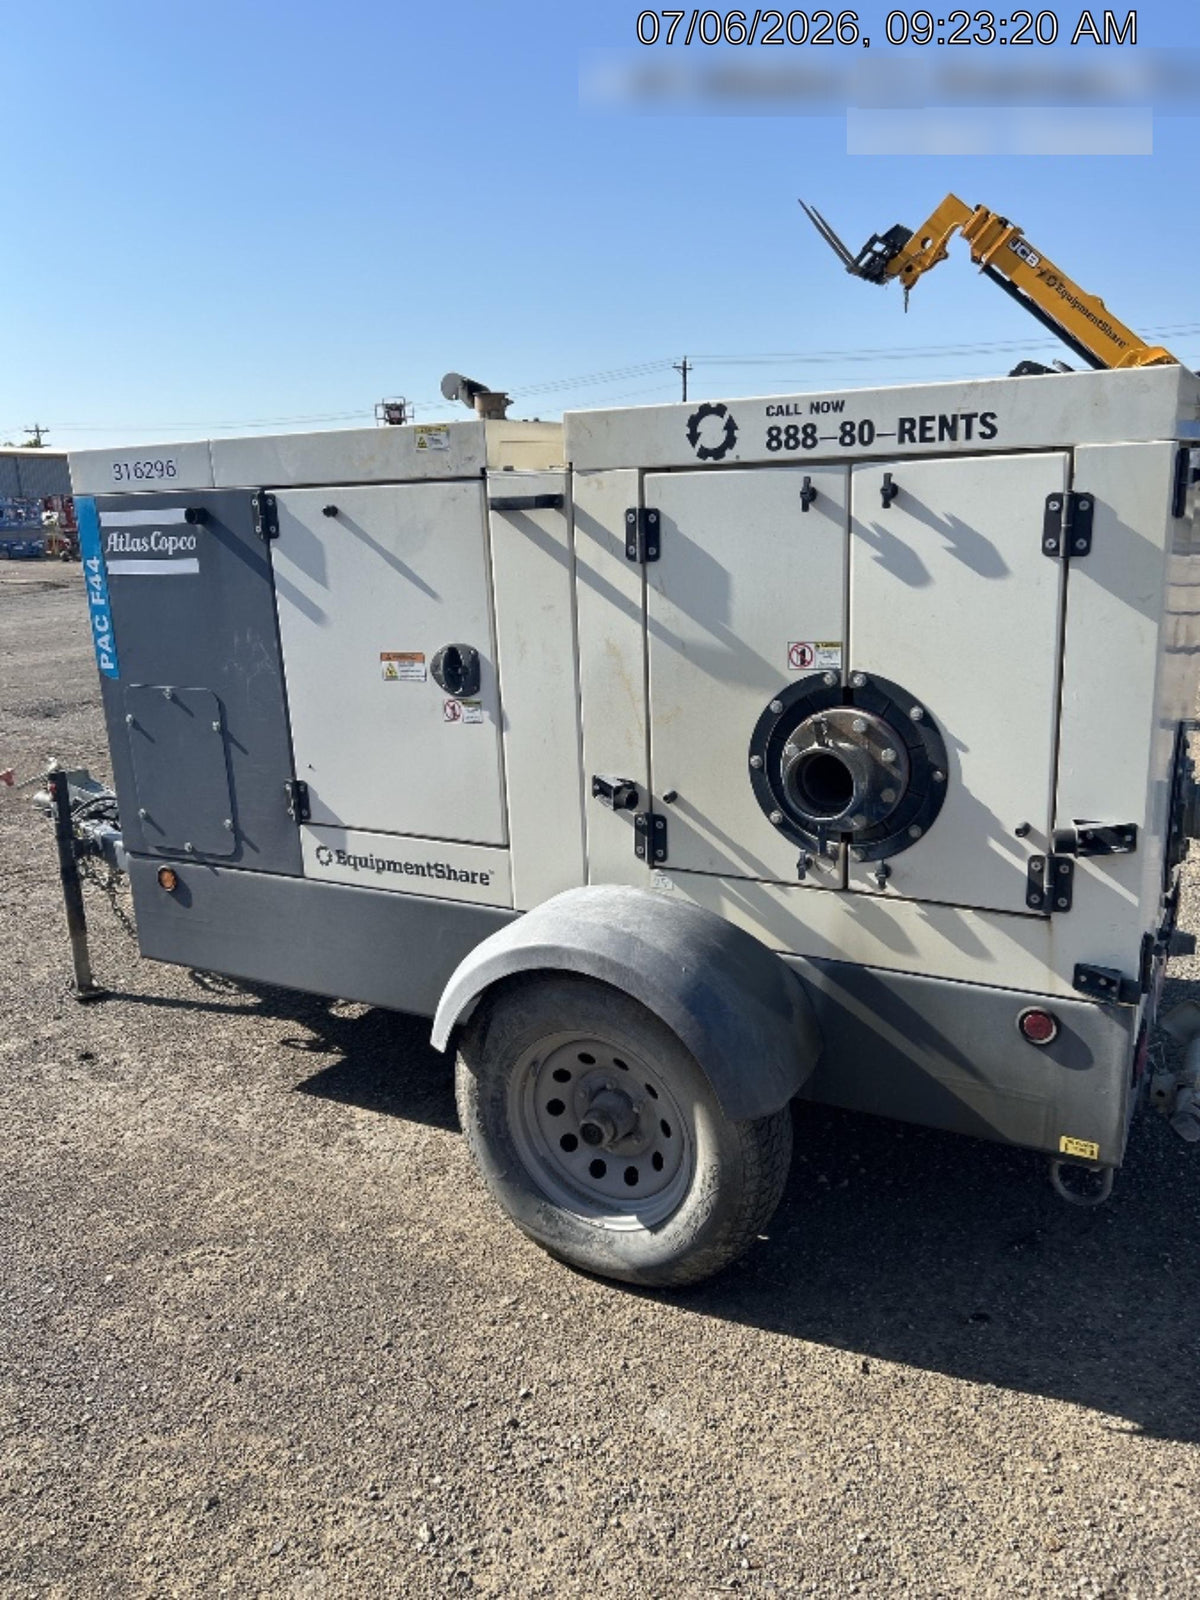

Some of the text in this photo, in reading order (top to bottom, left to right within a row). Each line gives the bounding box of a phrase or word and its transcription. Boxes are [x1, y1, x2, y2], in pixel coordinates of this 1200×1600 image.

[1008, 238, 1040, 268] JCB
[1055, 282, 1127, 349] EquipmentShare
[765, 400, 846, 417] CALL NOW
[112, 459, 177, 481] 316296
[105, 530, 197, 556] Atlas Copco
[86, 555, 115, 670] PAC F44
[335, 849, 490, 886] EquipmentShare
